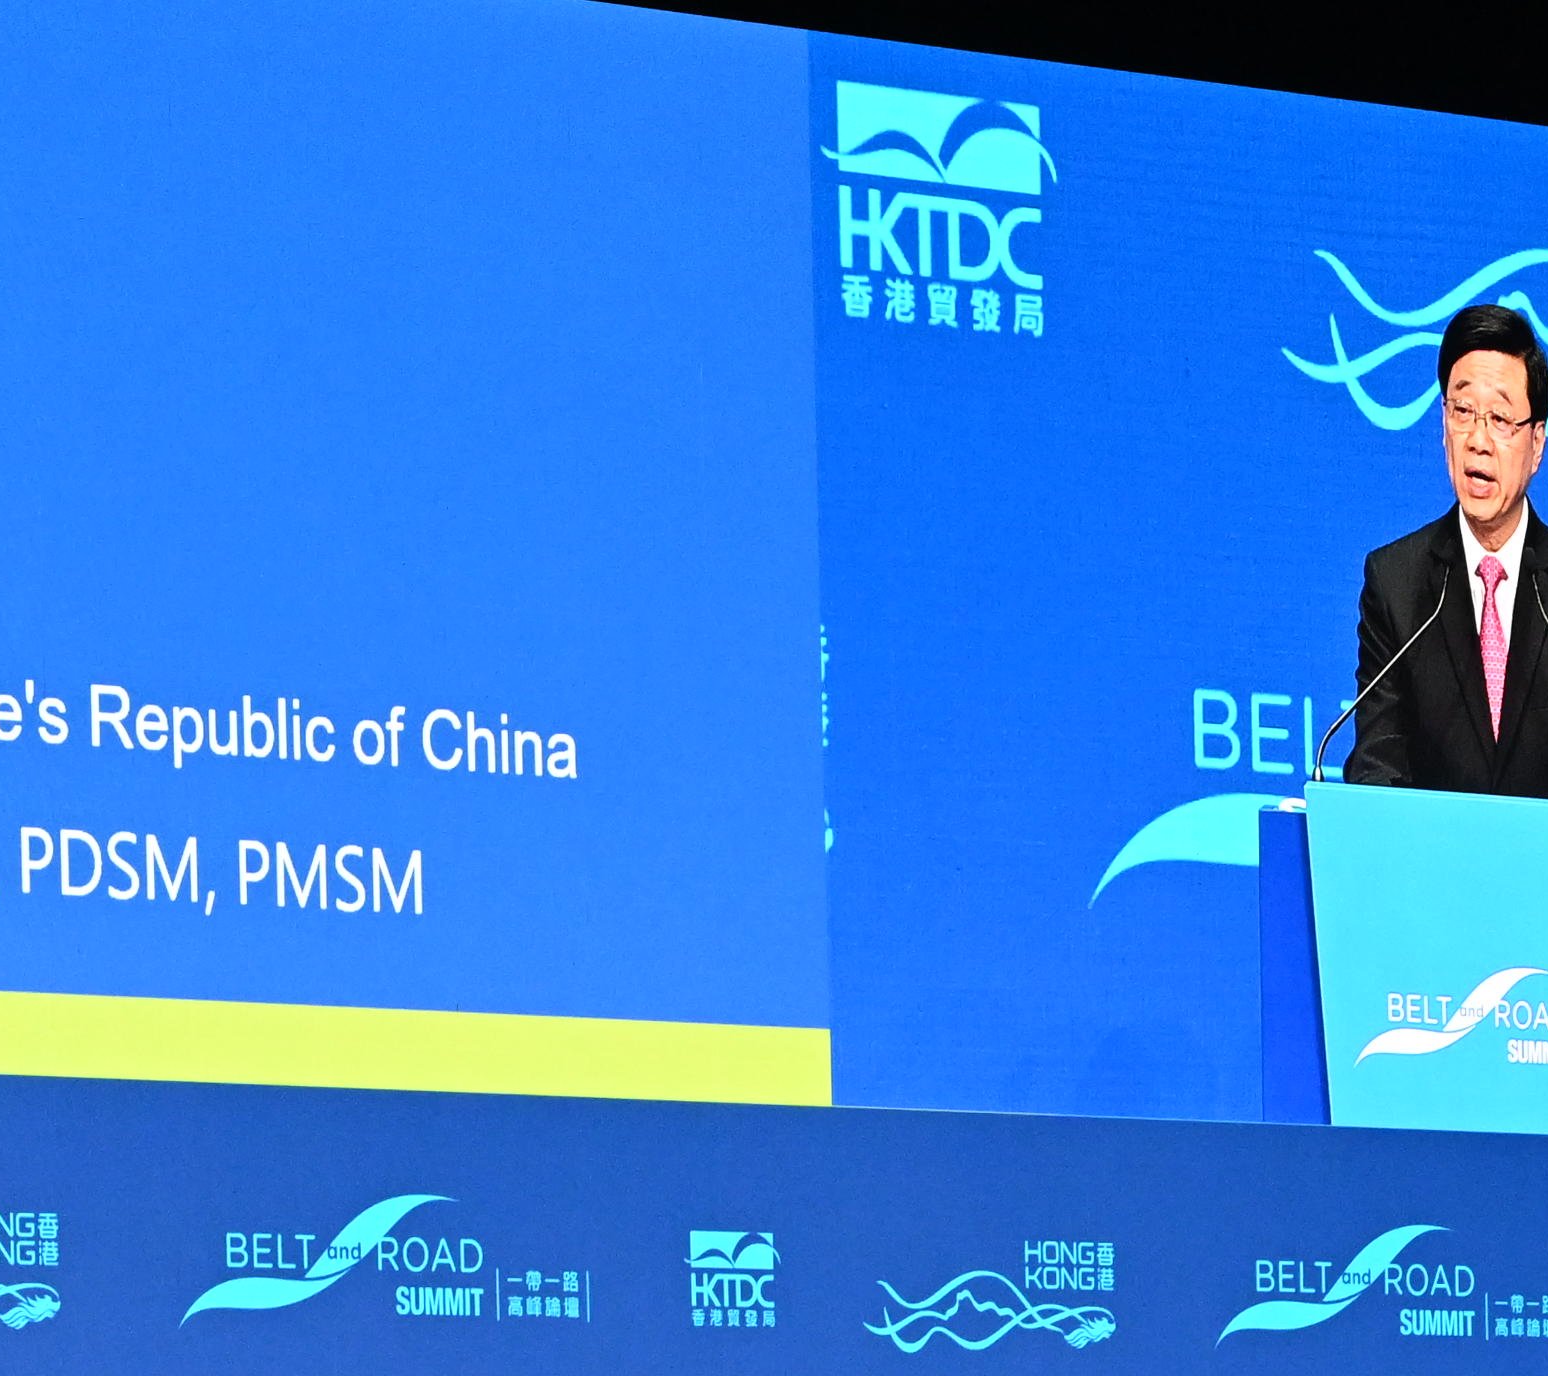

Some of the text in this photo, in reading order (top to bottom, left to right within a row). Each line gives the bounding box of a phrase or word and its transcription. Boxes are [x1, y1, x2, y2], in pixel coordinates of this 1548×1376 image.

[839, 183, 1043, 292] HKTDC
[841, 275, 1044, 338] 香港貿發局
[91, 684, 335, 768] Republic
[353, 706, 405, 766] of
[423, 709, 577, 778] China
[1193, 688, 1354, 777] BEL
[21, 827, 215, 915] PDSM,
[239, 840, 422, 914] PMSM
[1387, 993, 1452, 1025] BELT
